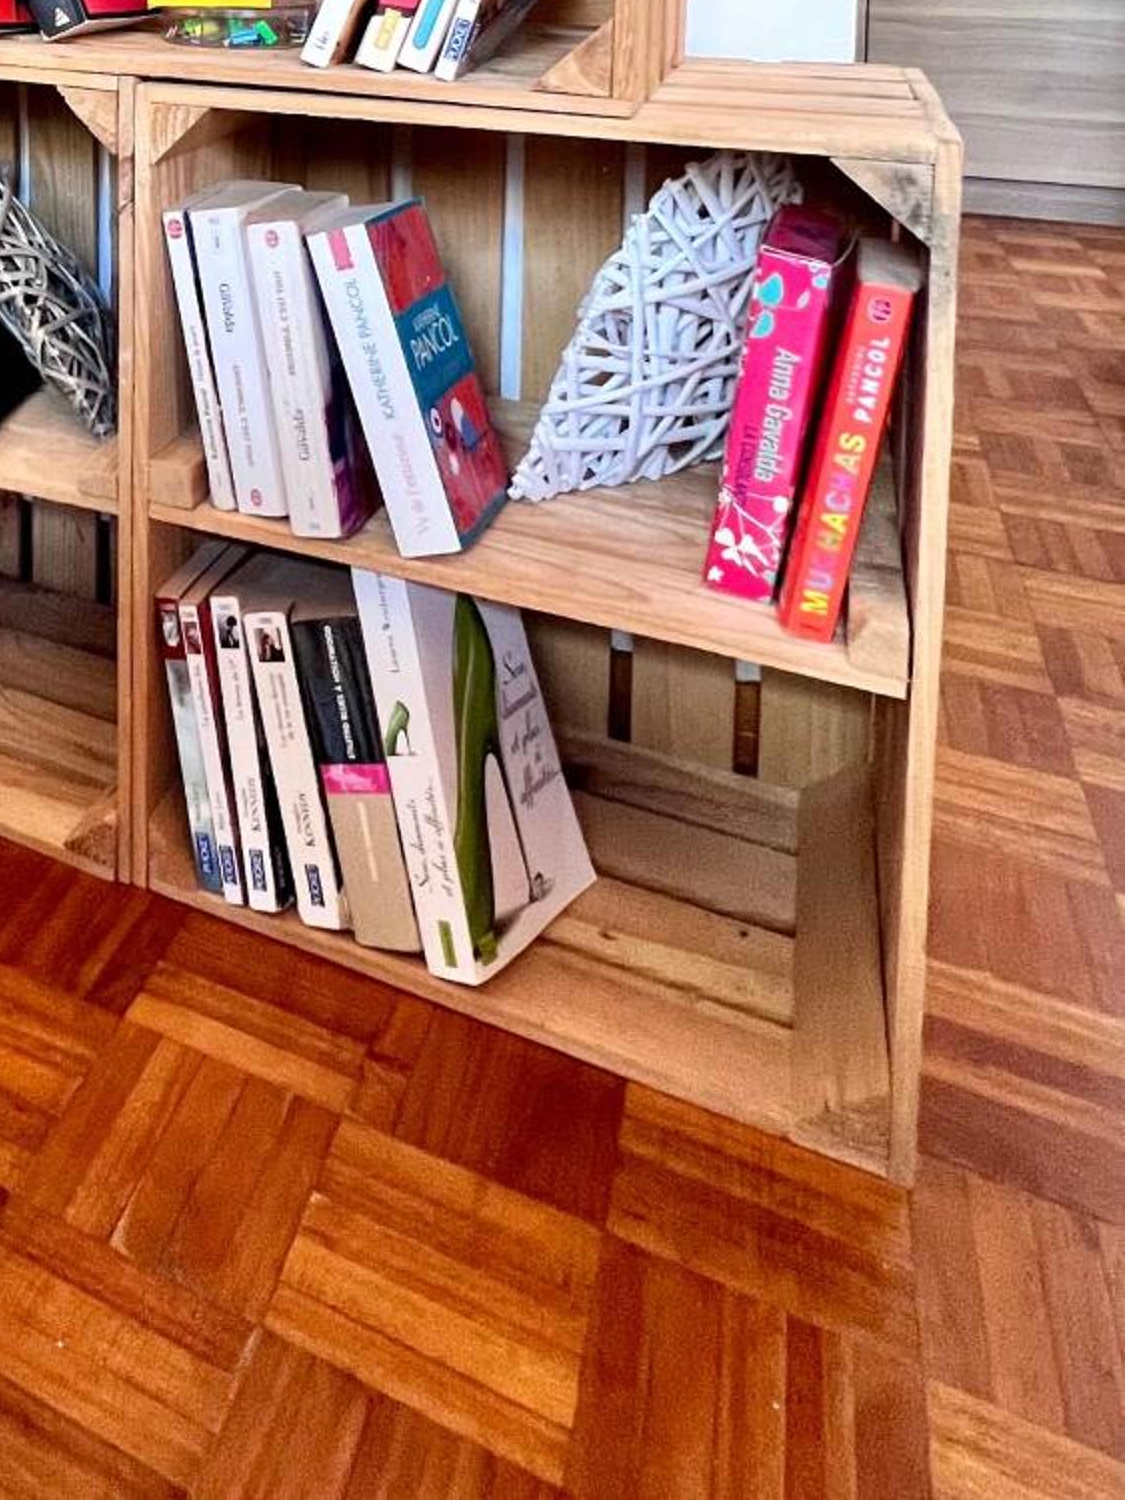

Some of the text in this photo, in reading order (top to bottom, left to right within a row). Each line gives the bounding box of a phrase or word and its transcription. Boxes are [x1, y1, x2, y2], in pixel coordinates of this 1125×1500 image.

[215, 281, 236, 333] Gavalda
[410, 314, 459, 371] PANCOL
[343, 278, 398, 420] KATHERINE PANCOL
[853, 336, 890, 424] PANCOL
[292, 407, 310, 462] Gavalda
[754, 346, 801, 484] Anna Gavalda
[799, 431, 867, 617] MUCHACHAS
[297, 791, 318, 849] KENNEDY
